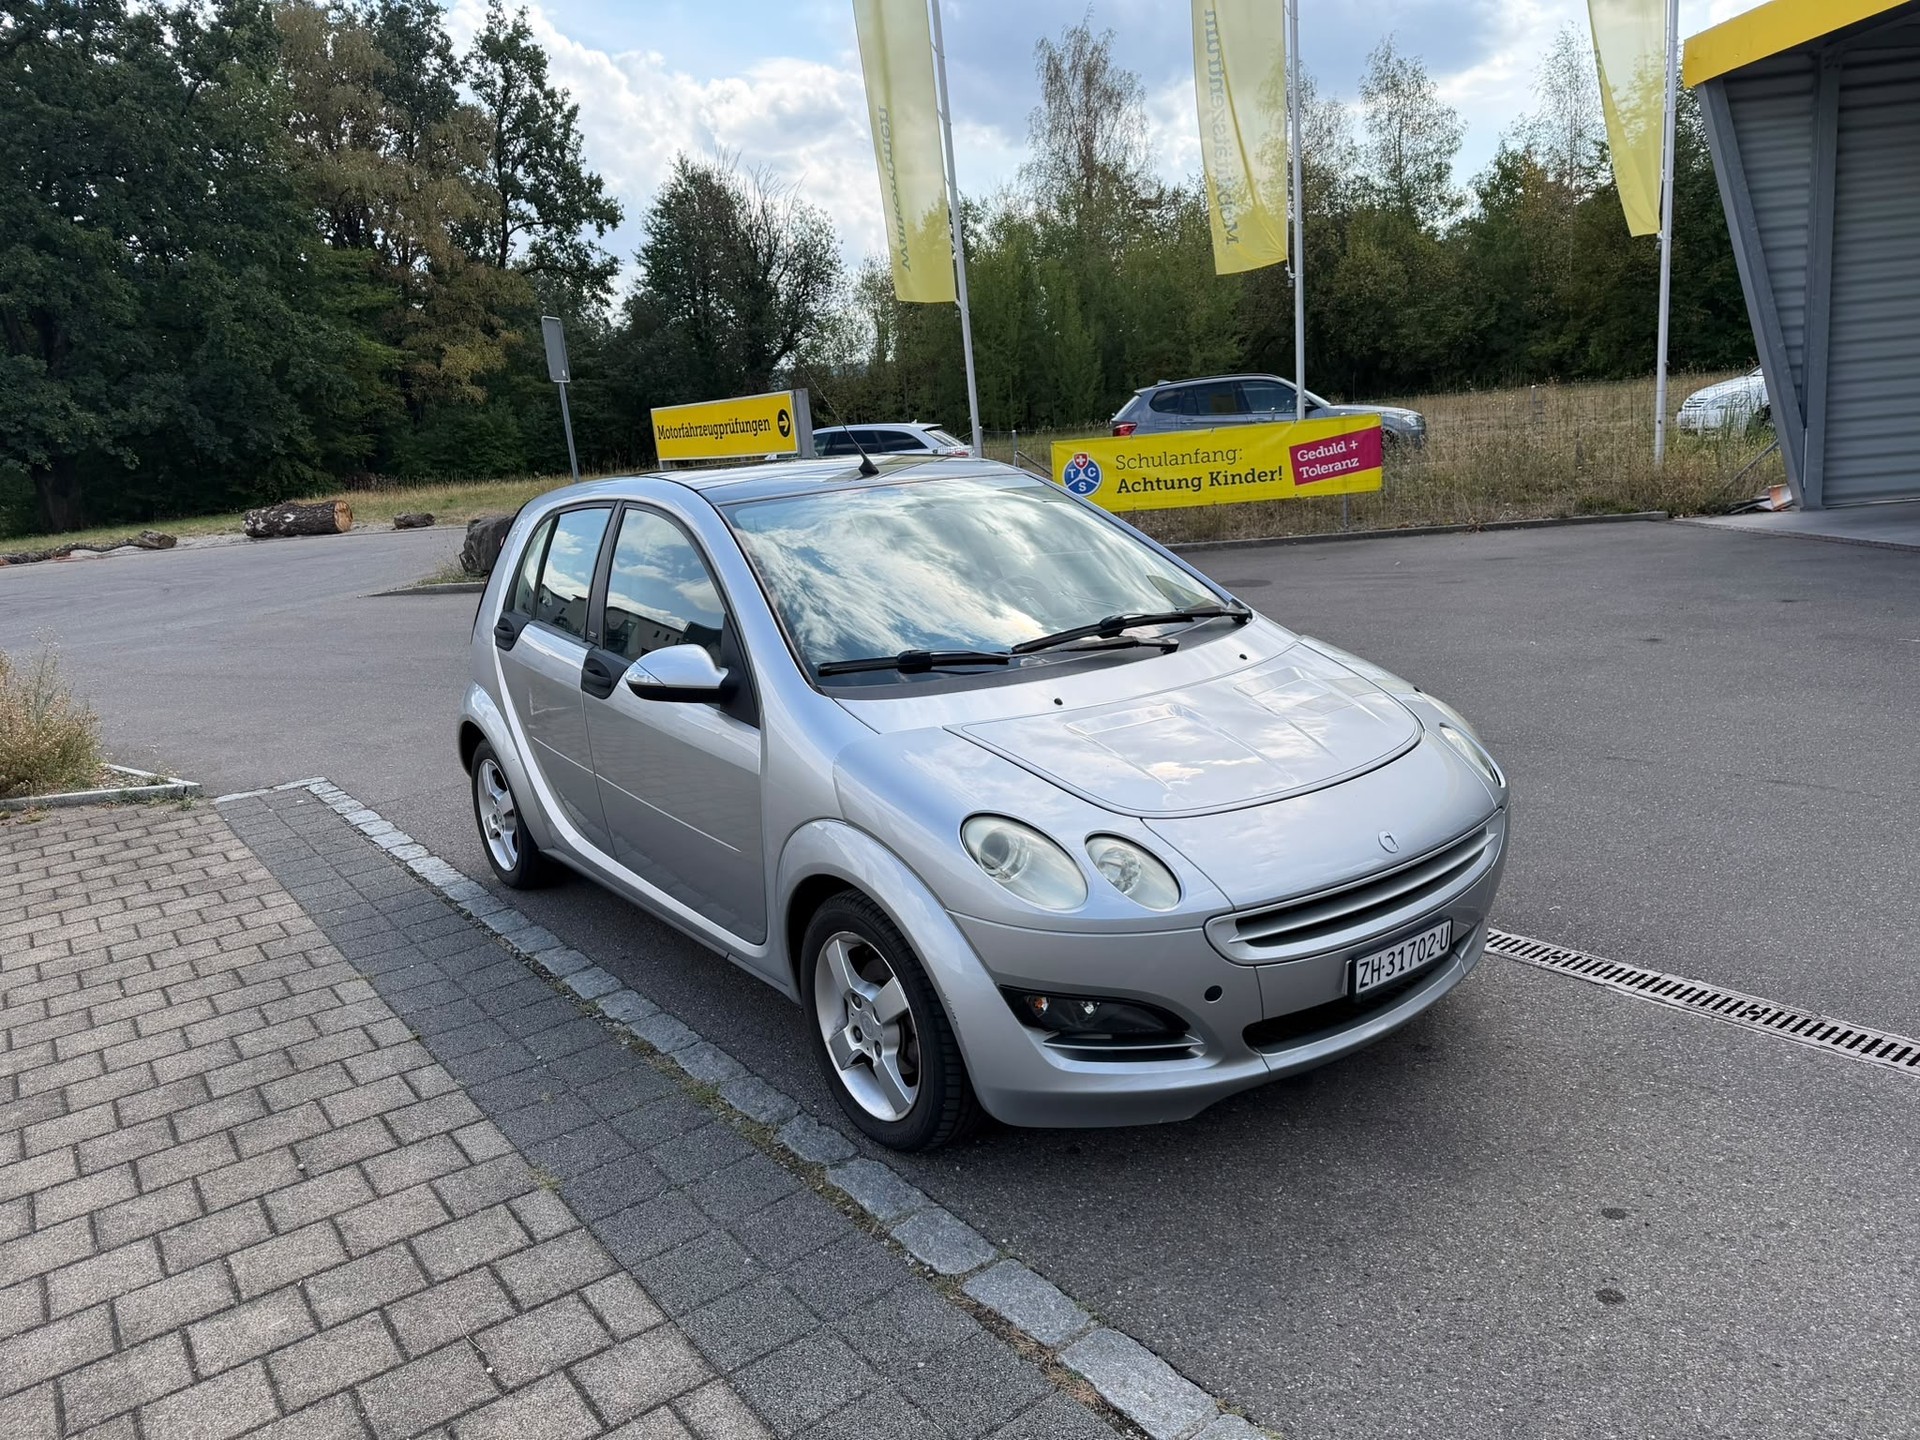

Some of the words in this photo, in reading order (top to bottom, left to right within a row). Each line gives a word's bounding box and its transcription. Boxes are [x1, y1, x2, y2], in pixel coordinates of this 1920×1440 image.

[656, 417, 771, 440] Motorfahrzeugprüfungen
[1115, 448, 1243, 471] Schulanfang:
[1297, 440, 1347, 462] Geduld
[1299, 457, 1360, 478] Toleranz
[1116, 475, 1203, 494] Achtung
[1208, 465, 1283, 487] Kinder!
